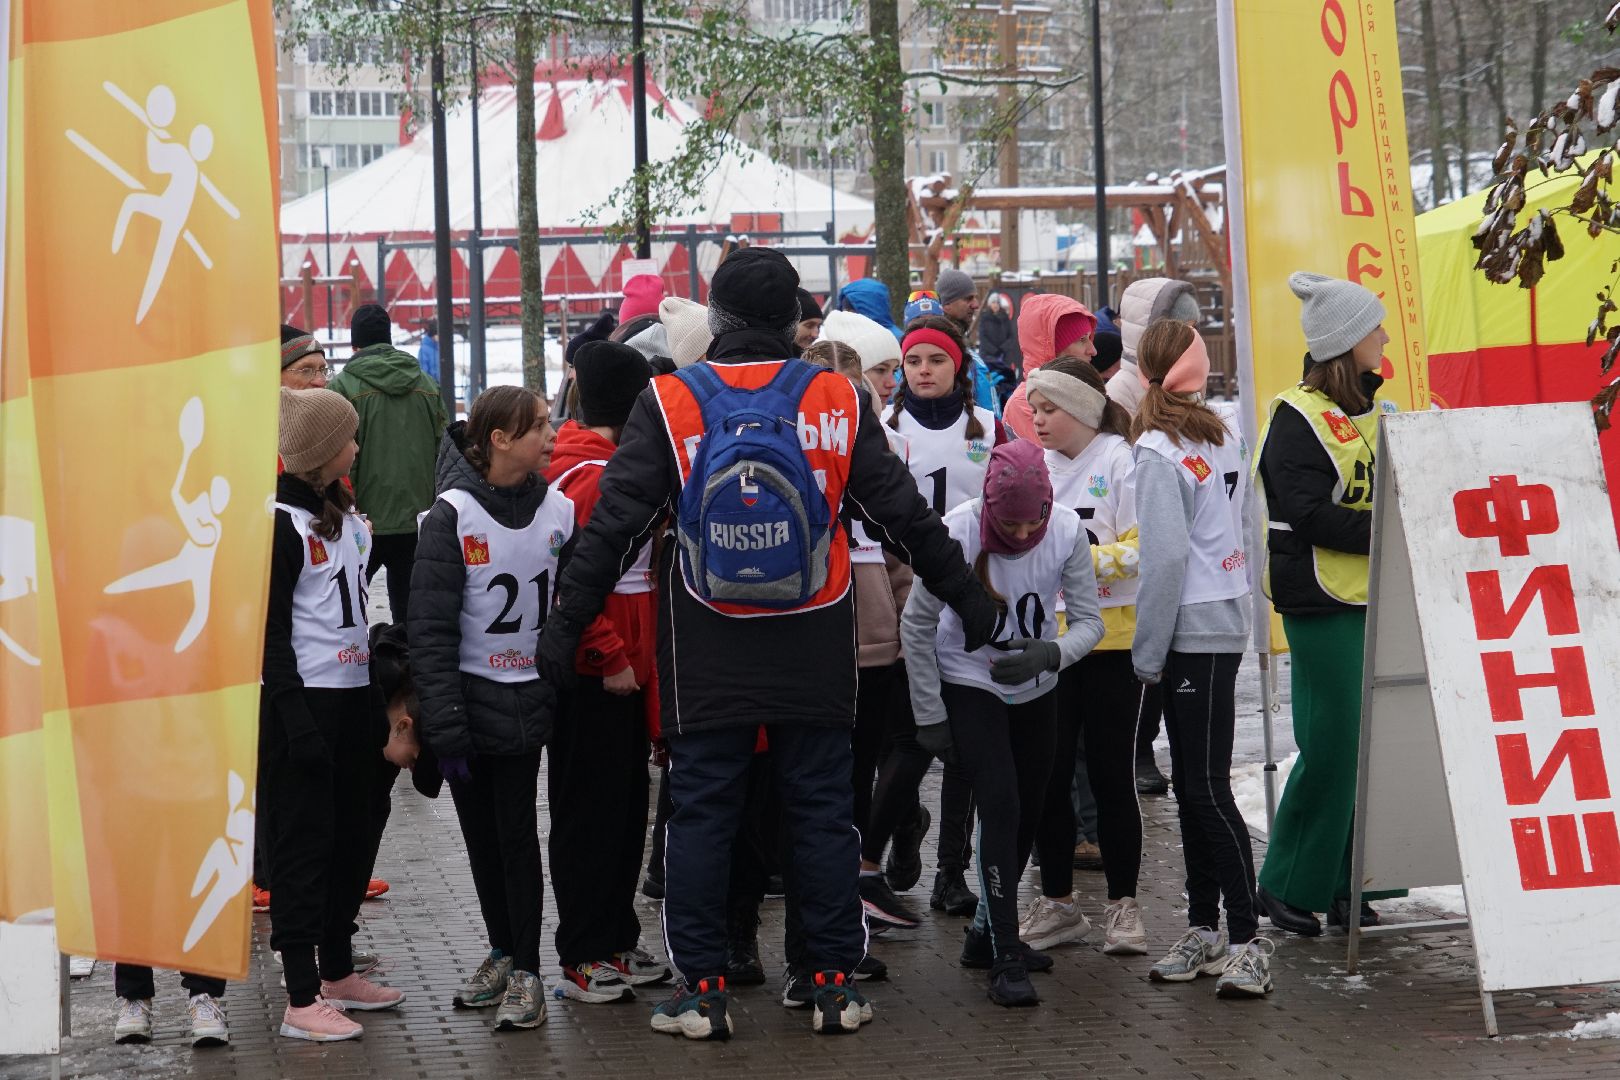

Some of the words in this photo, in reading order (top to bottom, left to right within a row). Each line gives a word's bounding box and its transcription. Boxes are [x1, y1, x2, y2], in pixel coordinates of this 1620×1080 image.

[1395, 228, 1417, 324] Строим
[709, 520, 790, 551] RUSSIA
[485, 568, 549, 634] 21
[1453, 475, 1620, 891] ФИНИШ
[989, 865, 1004, 898] FILA
